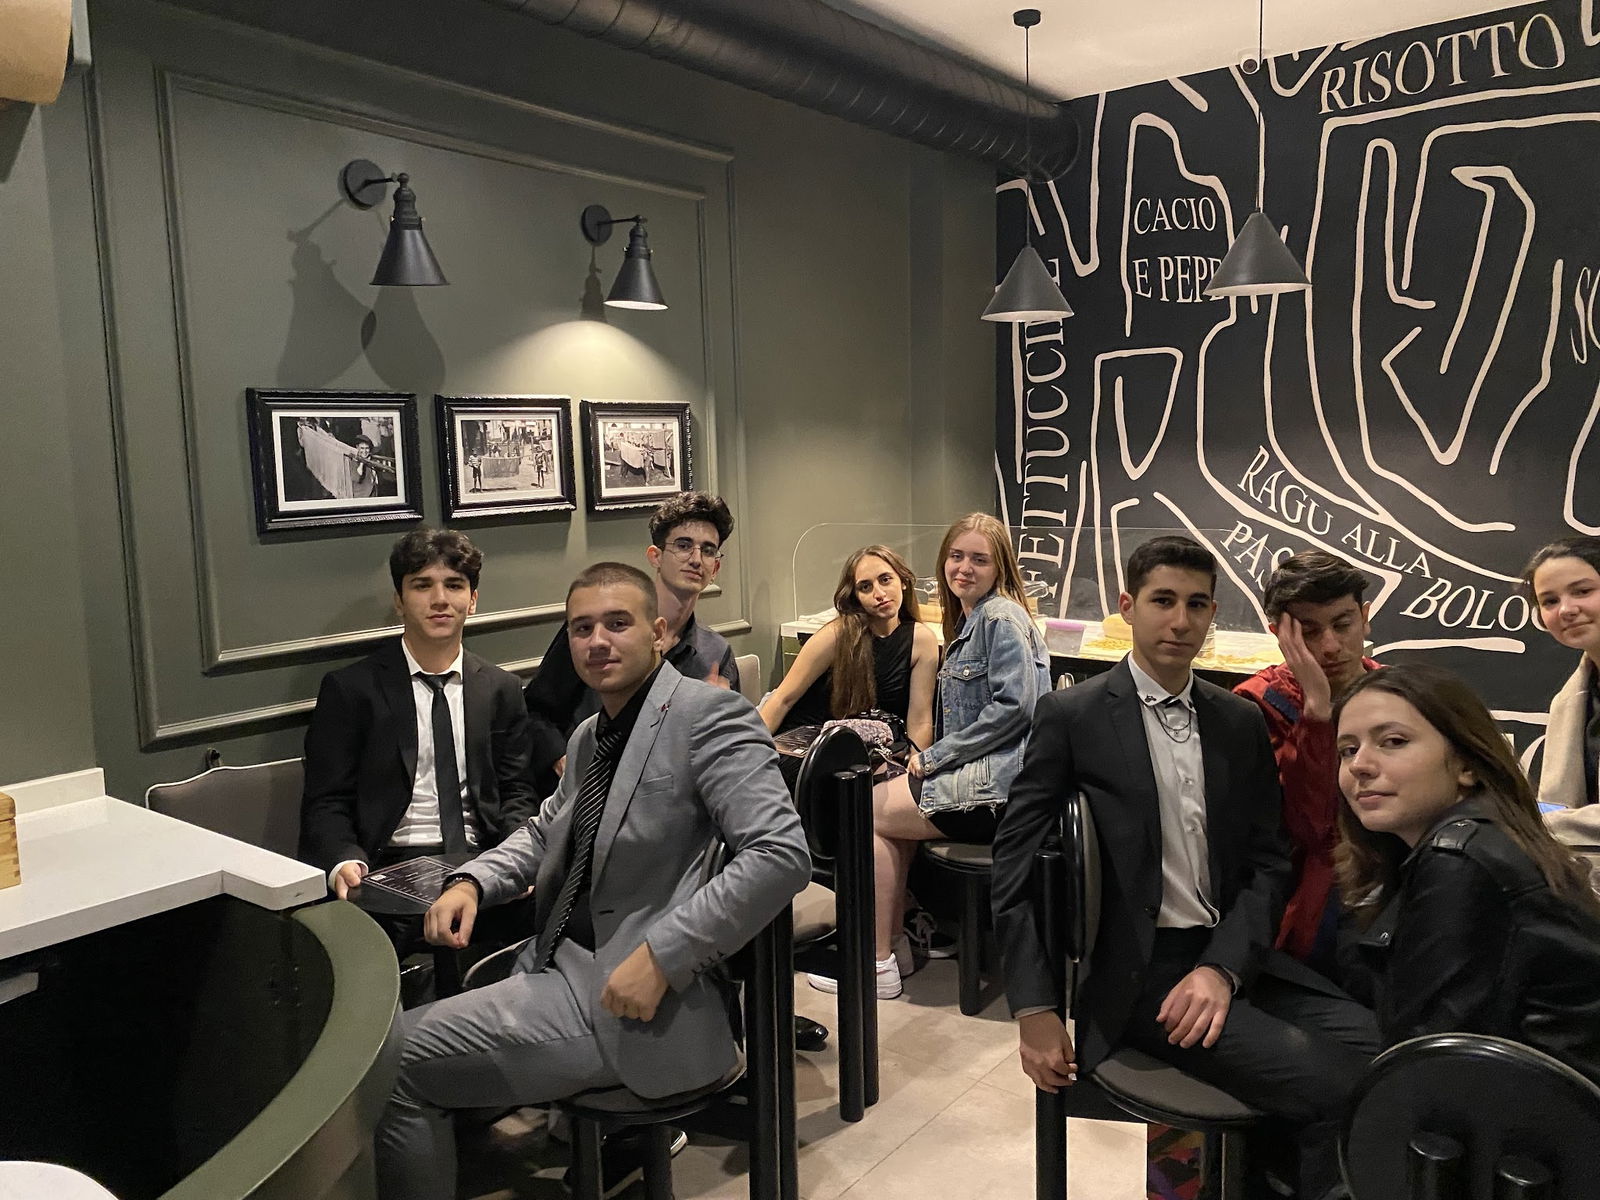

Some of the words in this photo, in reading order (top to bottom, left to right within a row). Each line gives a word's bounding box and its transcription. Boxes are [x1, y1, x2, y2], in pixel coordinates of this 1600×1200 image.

[1318, 13, 1566, 115] RISOTTO
[1133, 196, 1217, 235] CACIO
[1132, 258, 1153, 299] E
[1017, 258, 1073, 599] FETTUCCI
[1237, 444, 1335, 536] RAGU
[1340, 522, 1433, 580] ALLA
